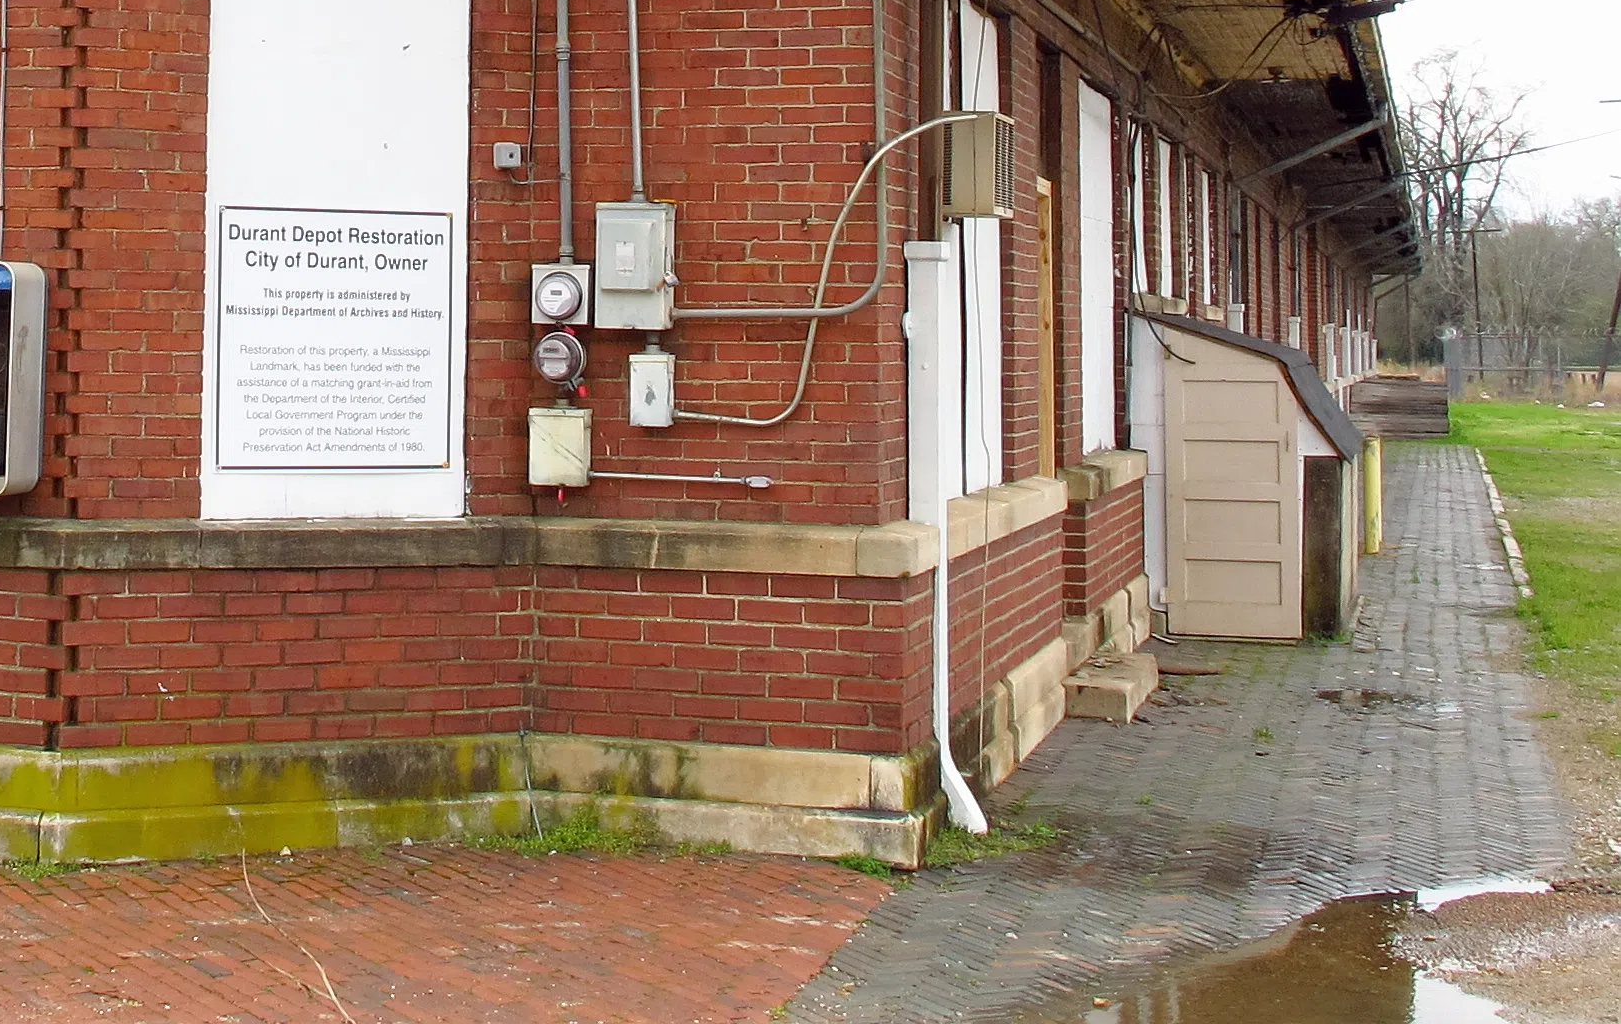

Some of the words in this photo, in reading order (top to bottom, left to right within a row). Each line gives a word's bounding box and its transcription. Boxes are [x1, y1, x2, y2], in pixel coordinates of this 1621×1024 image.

[229, 224, 286, 241] Durant
[293, 226, 342, 246] Depot
[349, 228, 443, 245] Restoration
[246, 250, 278, 271] City
[285, 252, 301, 268] of
[308, 252, 368, 272] Durant,
[375, 254, 428, 271] Owner
[263, 288, 282, 298] This
[285, 290, 323, 301] property
[327, 289, 335, 299] is
[338, 290, 397, 300] administered
[400, 291, 410, 302] by
[226, 305, 278, 317] Mississippi
[282, 305, 336, 318] Department
[339, 307, 347, 317] of
[350, 307, 389, 317] Archives
[392, 309, 408, 318] and
[240, 345, 294, 355] Restoration
[297, 345, 306, 355] of
[310, 345, 326, 355] this
[382, 347, 430, 357] Mississippi
[304, 362, 321, 371] has
[324, 363, 347, 371] been
[351, 362, 382, 372] funded
[385, 363, 403, 372] with
[406, 364, 420, 372] the
[237, 378, 287, 387] assistance
[290, 377, 299, 387] of
[311, 378, 354, 389] matching
[357, 378, 410, 389] grant-in-aid
[412, 378, 432, 388] from
[244, 393, 259, 403] the
[262, 394, 317, 404] Department
[320, 394, 329, 404] of
[332, 394, 347, 403] the
[388, 394, 426, 404] Certified
[246, 409, 272, 419] Local
[275, 410, 333, 421] Government
[337, 410, 377, 422] Program
[380, 410, 406, 420] under
[409, 411, 423, 420] the
[259, 426, 302, 437] provision
[305, 426, 314, 436] of
[317, 427, 331, 436] the
[335, 426, 373, 436] National
[376, 426, 410, 436] Historic
[243, 442, 303, 452] Preservation
[306, 443, 321, 452] Act
[324, 442, 386, 452] Amendments
[389, 442, 398, 452] of
[401, 442, 425, 452] 1980.
